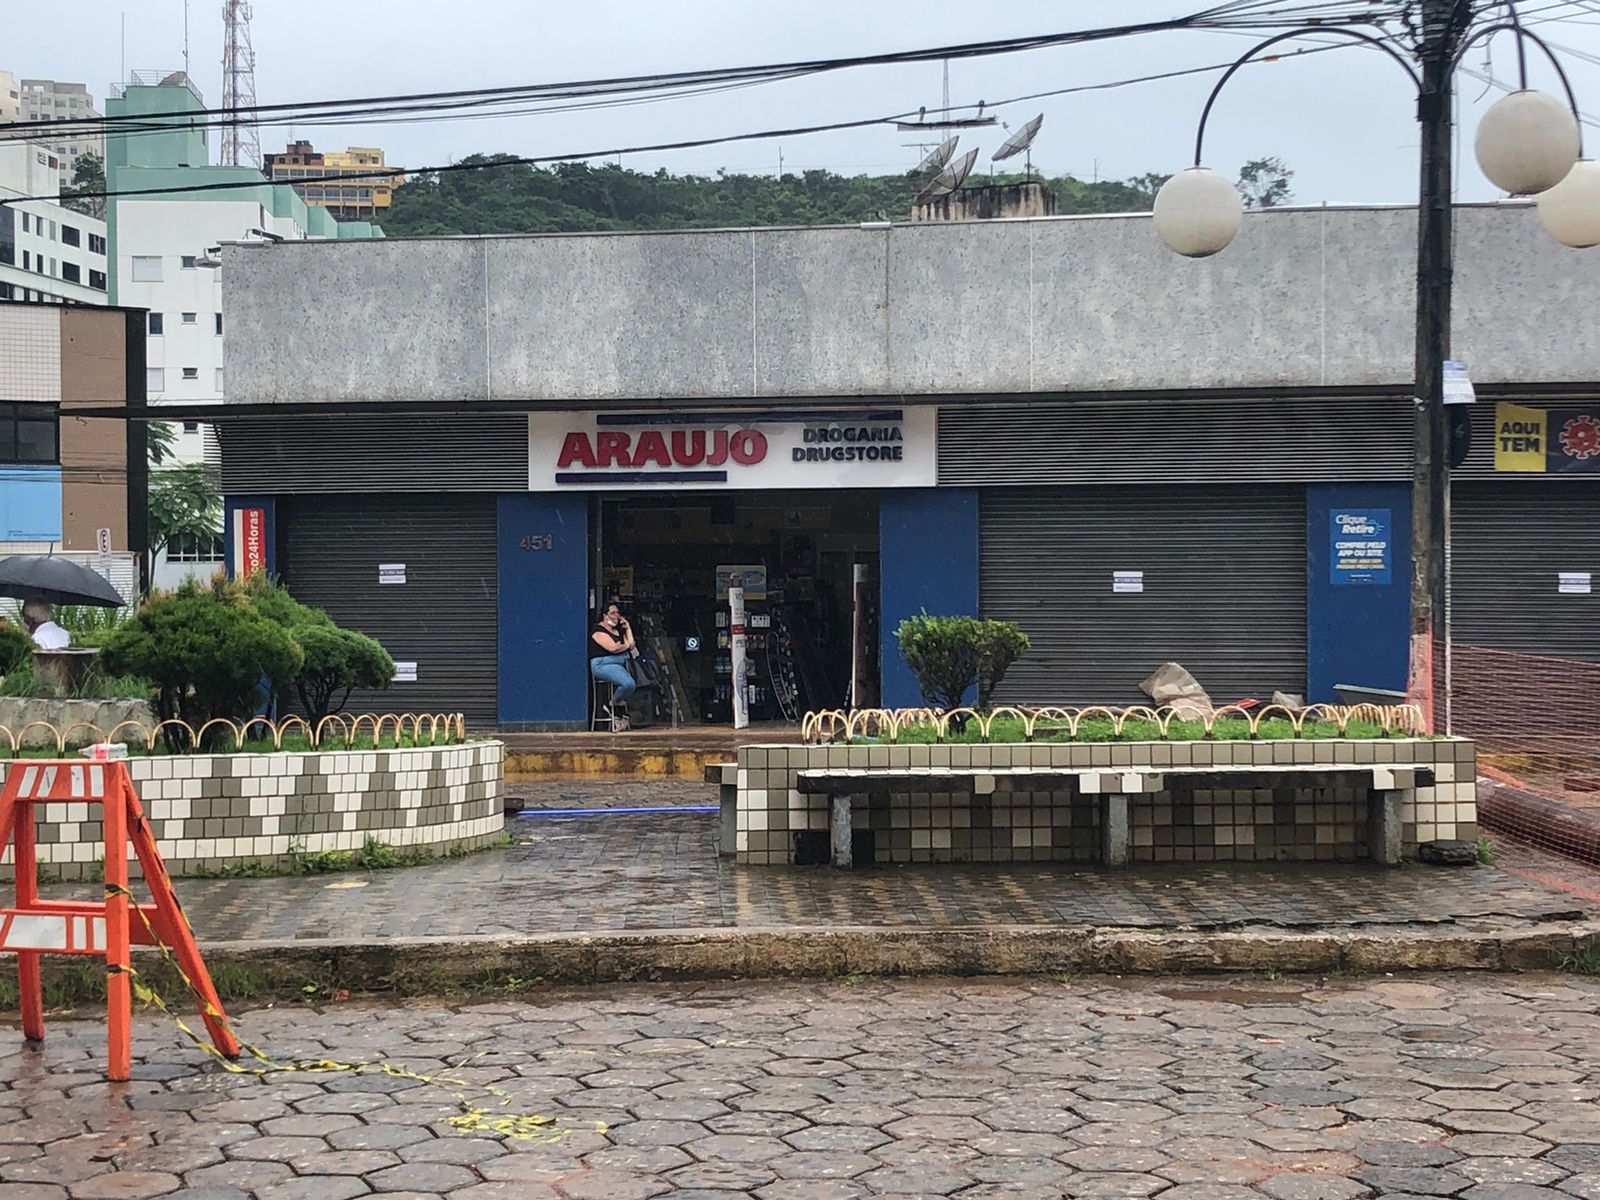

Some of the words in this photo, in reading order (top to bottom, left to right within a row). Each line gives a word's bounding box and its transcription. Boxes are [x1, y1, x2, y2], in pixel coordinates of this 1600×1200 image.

[803, 427, 903, 443] DROGARIA
[1501, 422, 1540, 435] AQUI
[557, 429, 768, 467] ARAUJO
[1500, 437, 1540, 452] TEM
[792, 446, 903, 462] DRUGSTORE
[1341, 524, 1375, 534] Retire
[248, 510, 259, 574] co24Horas
[519, 534, 553, 550] 451
[1337, 549, 1354, 557] APP
[1354, 549, 1366, 557] OU
